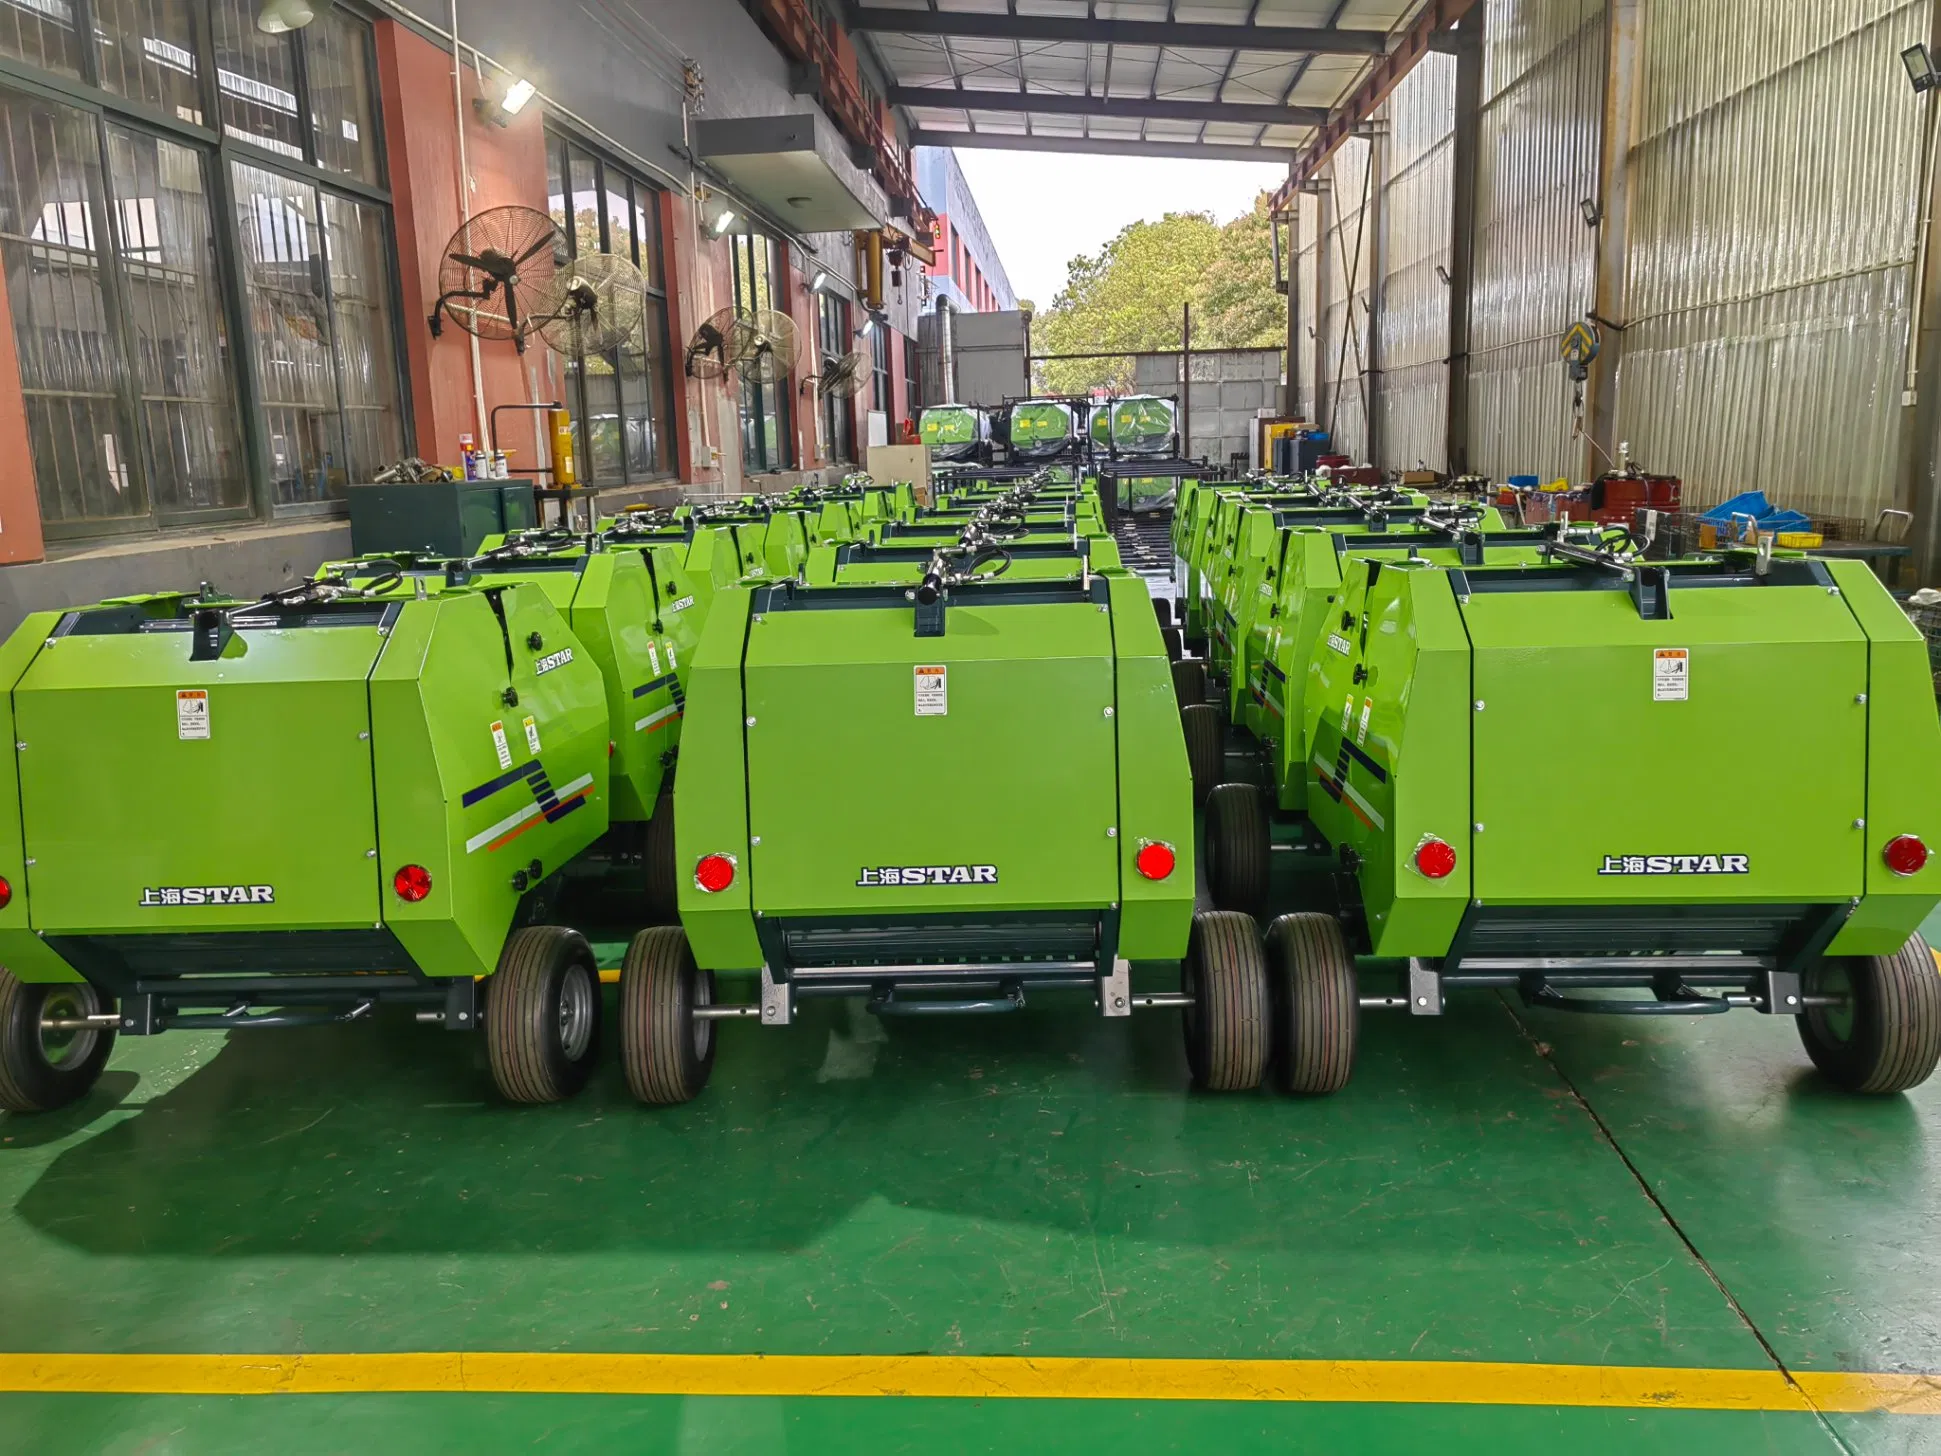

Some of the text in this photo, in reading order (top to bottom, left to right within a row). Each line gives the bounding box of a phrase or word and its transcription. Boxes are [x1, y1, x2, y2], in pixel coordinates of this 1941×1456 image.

[1599, 854, 1749, 874] 上海STAR
[856, 865, 997, 885] 上海STAR
[140, 885, 274, 905] 上海STAR
